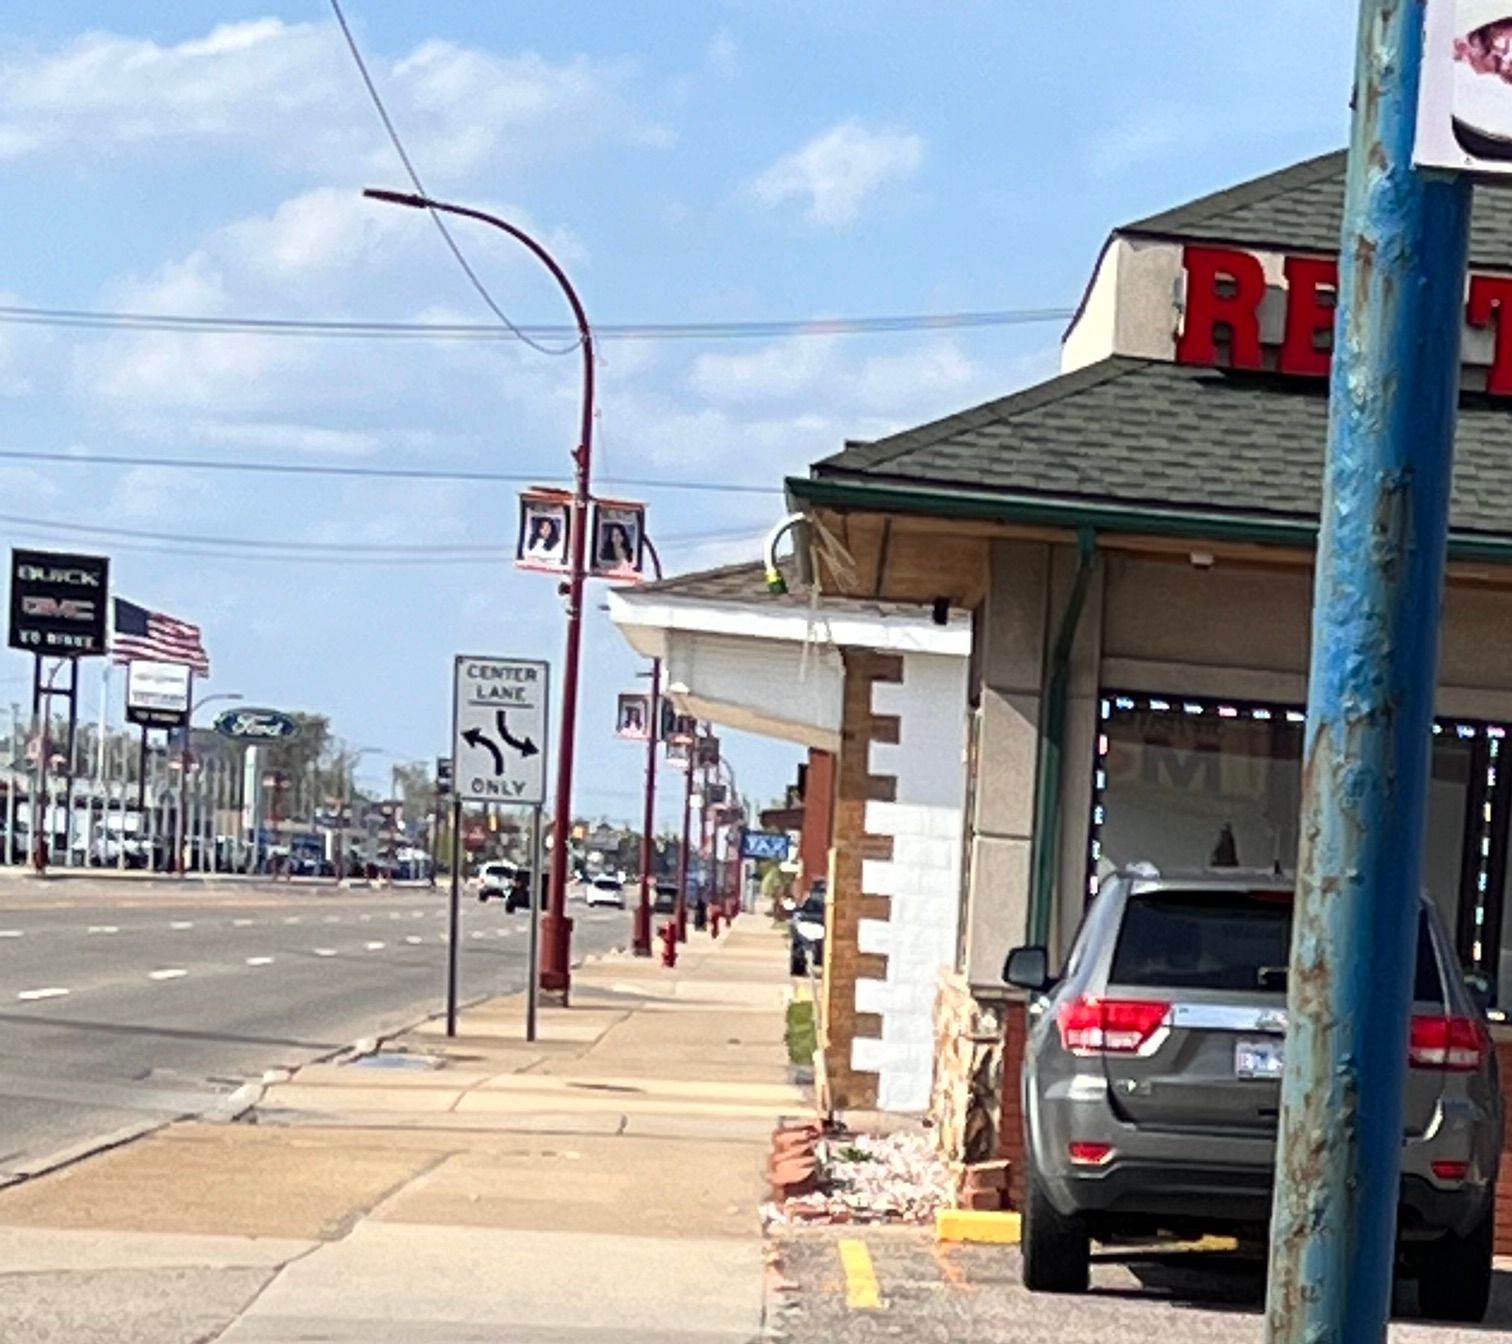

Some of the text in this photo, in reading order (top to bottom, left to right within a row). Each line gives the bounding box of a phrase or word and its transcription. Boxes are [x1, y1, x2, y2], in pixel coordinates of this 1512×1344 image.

[22, 596, 95, 621] GMC
[467, 664, 537, 683] CENTER
[476, 684, 526, 701] LANE
[231, 712, 284, 736] Ford
[471, 777, 526, 796] ONLY
